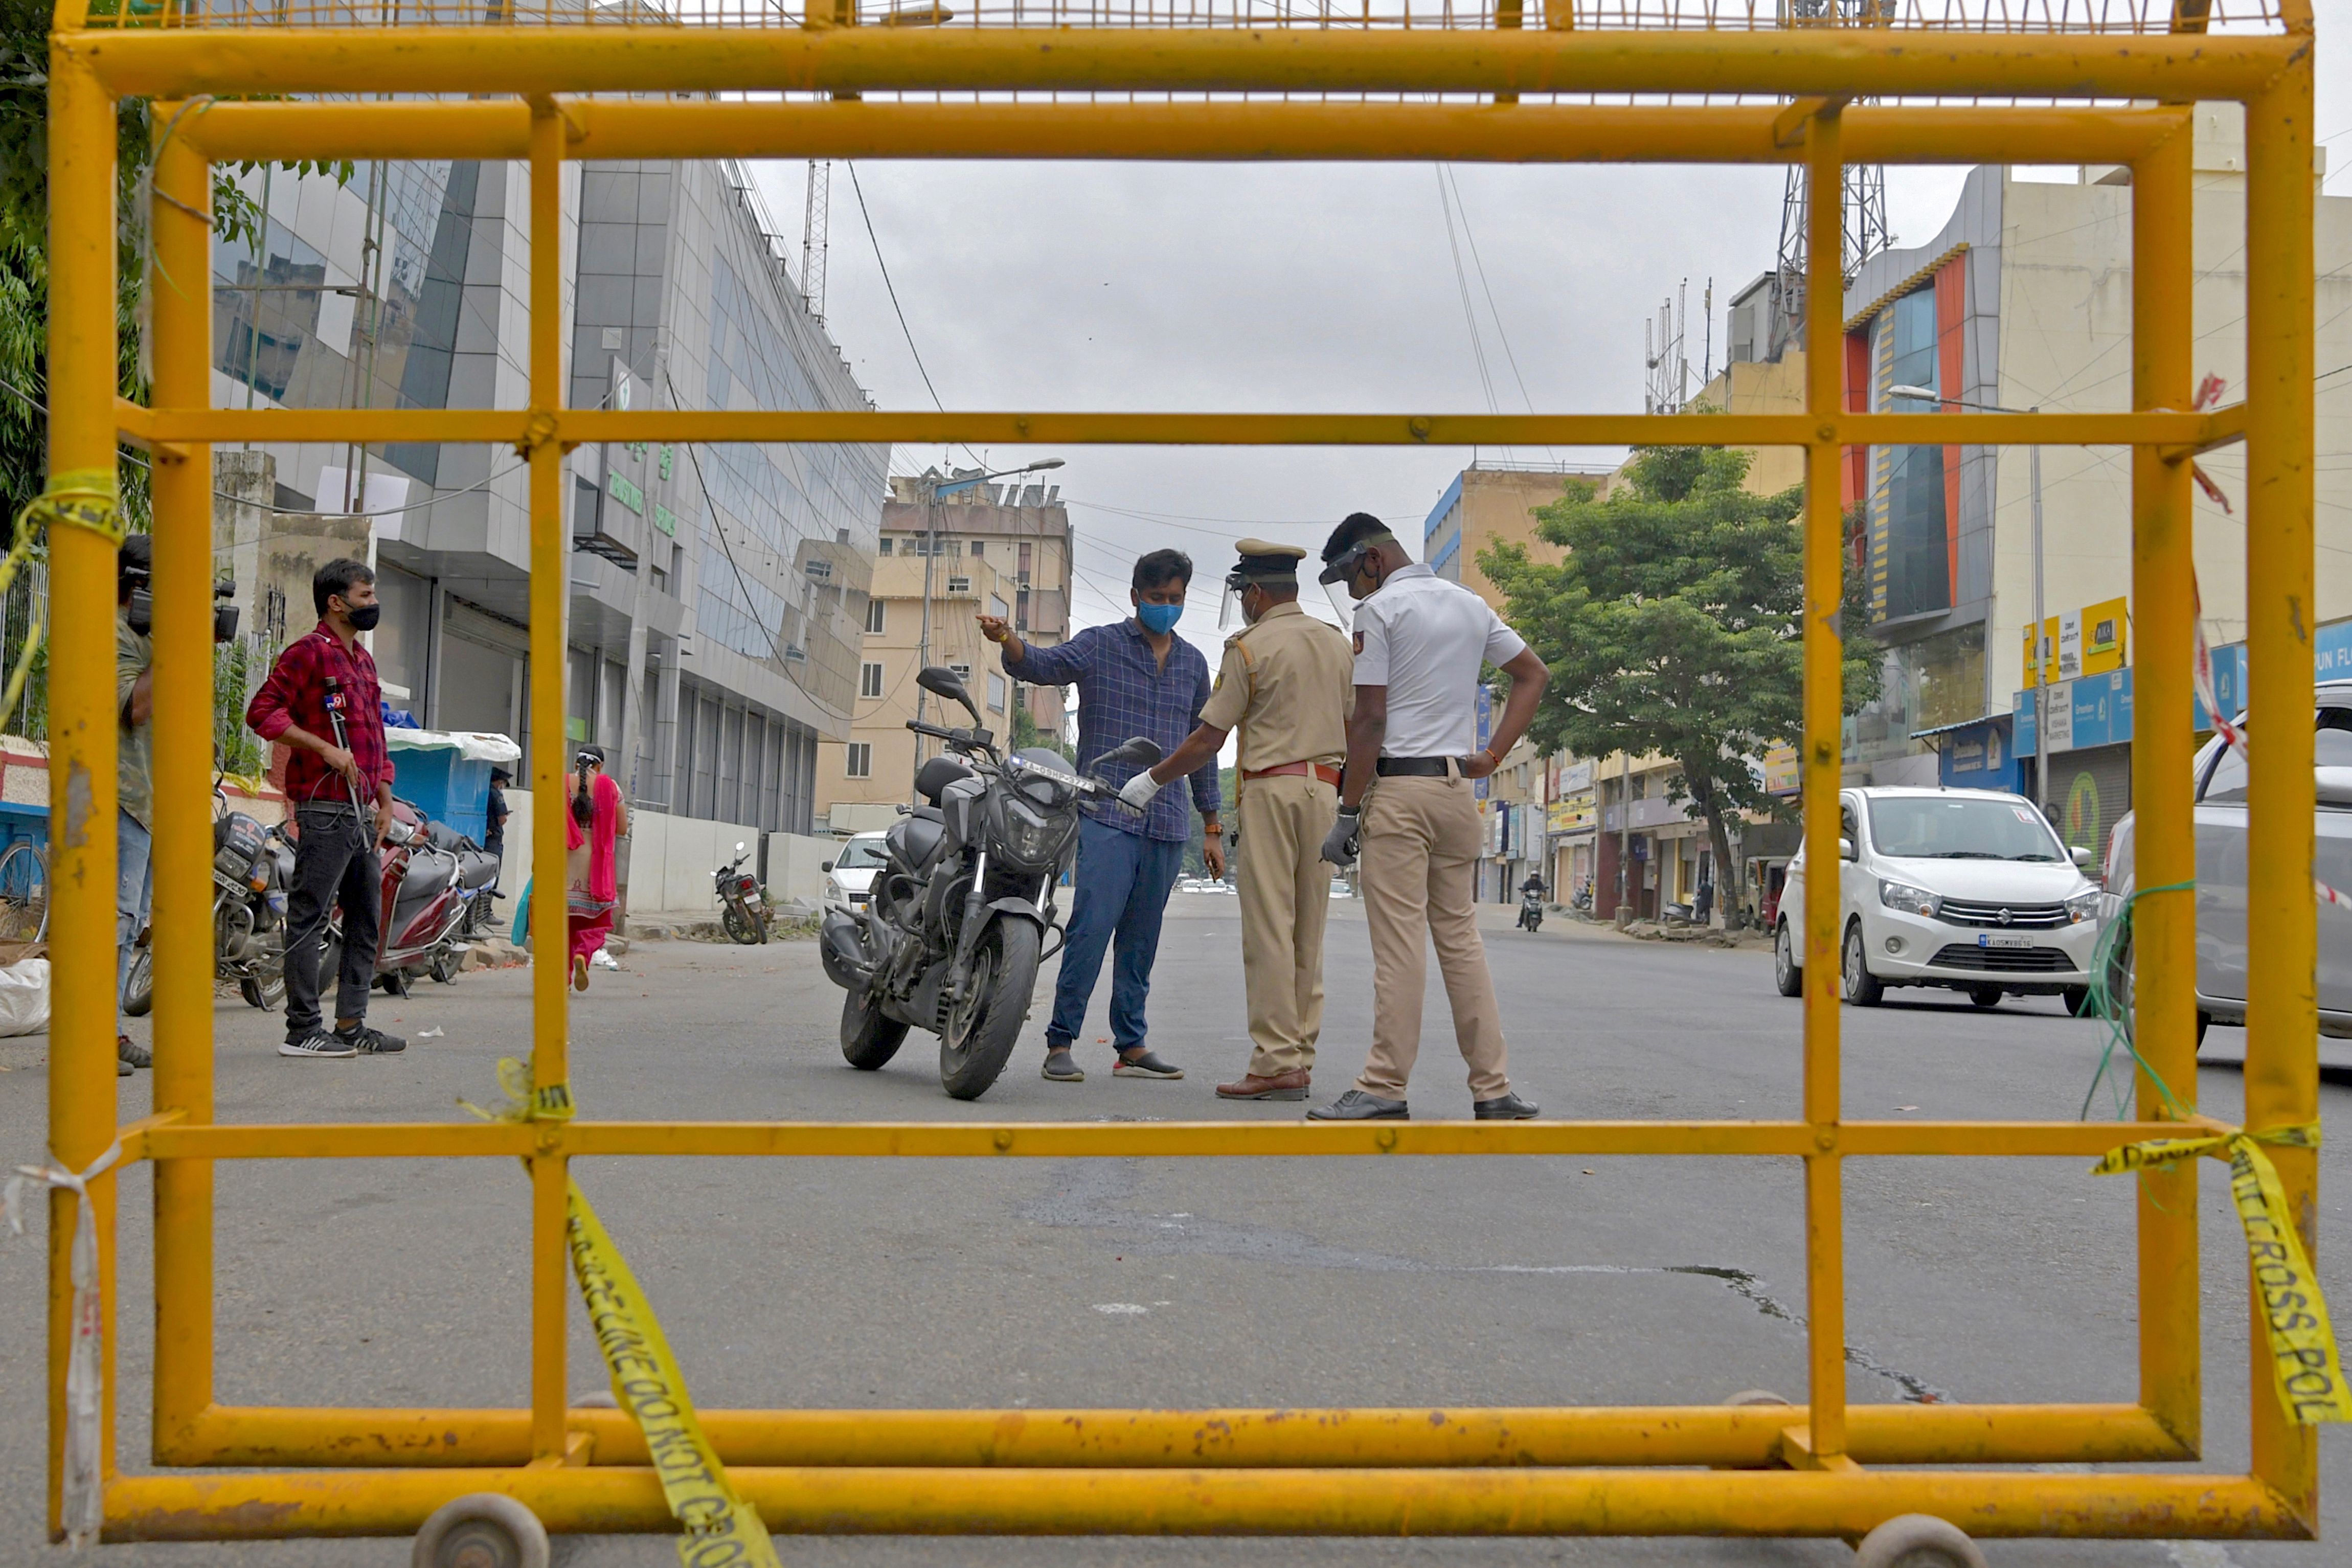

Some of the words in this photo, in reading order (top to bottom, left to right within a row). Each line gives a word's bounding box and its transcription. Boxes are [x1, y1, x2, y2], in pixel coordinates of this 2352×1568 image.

[1023, 760, 1094, 791] KA-09HP-3773
[624, 1380, 680, 1419] DO
[645, 1428, 715, 1484] NOT
